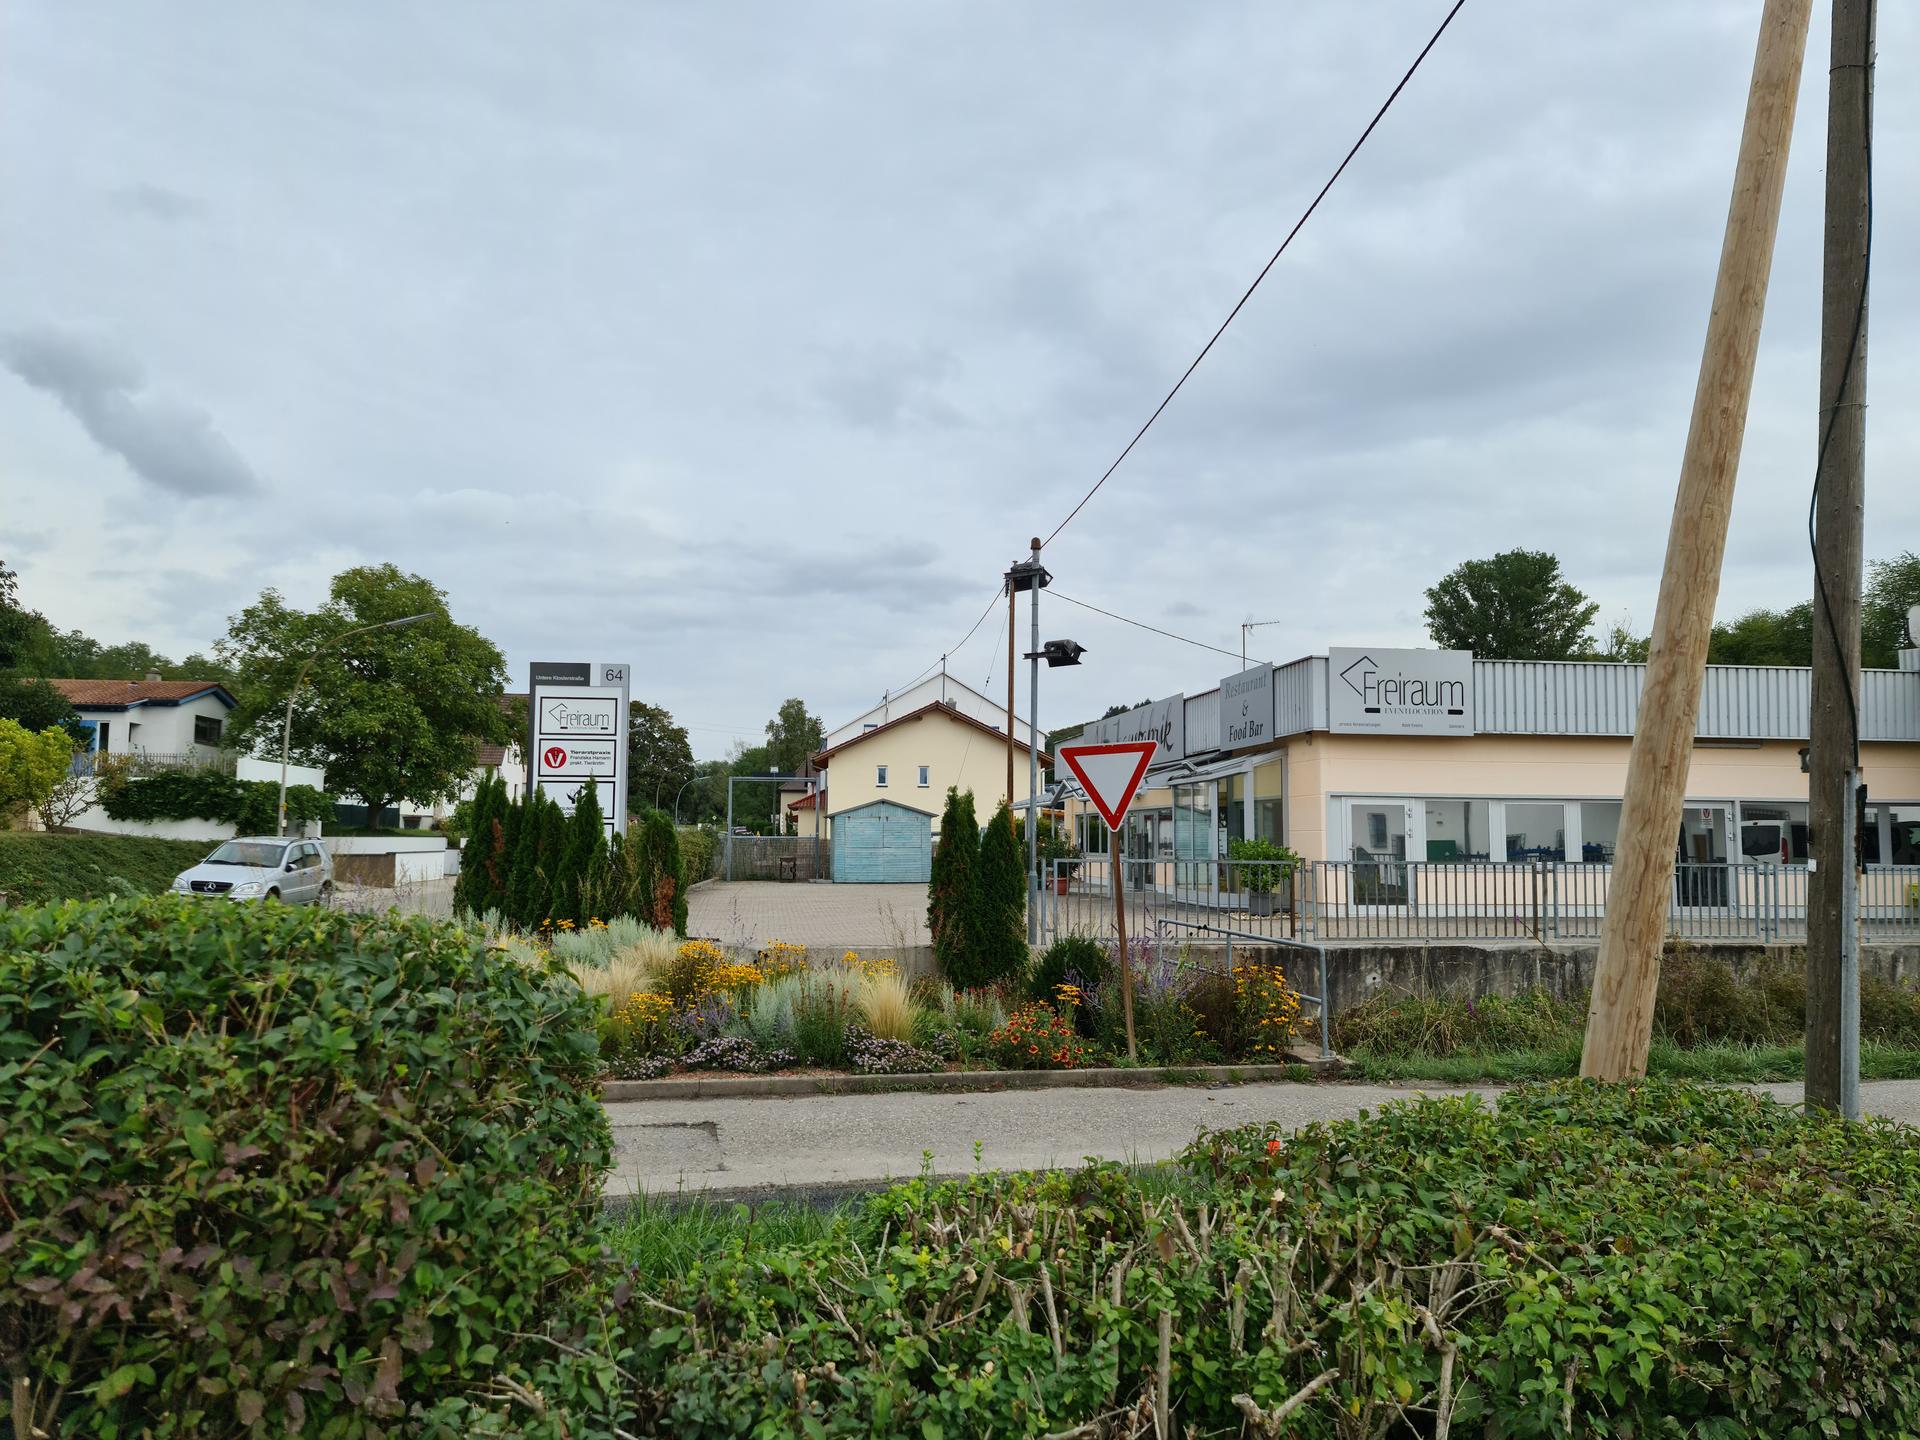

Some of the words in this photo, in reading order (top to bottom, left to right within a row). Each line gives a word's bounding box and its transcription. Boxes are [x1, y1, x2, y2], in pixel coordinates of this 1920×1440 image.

[605, 669, 623, 682] 64
[1225, 671, 1267, 700] Restaurant
[1363, 671, 1465, 707] Freiraum
[1242, 699, 1249, 717] &
[1384, 708, 1444, 716] EVENTLOCATION
[559, 709, 610, 727] Freiraum
[1229, 721, 1248, 742] Food
[1248, 720, 1264, 738] Bar
